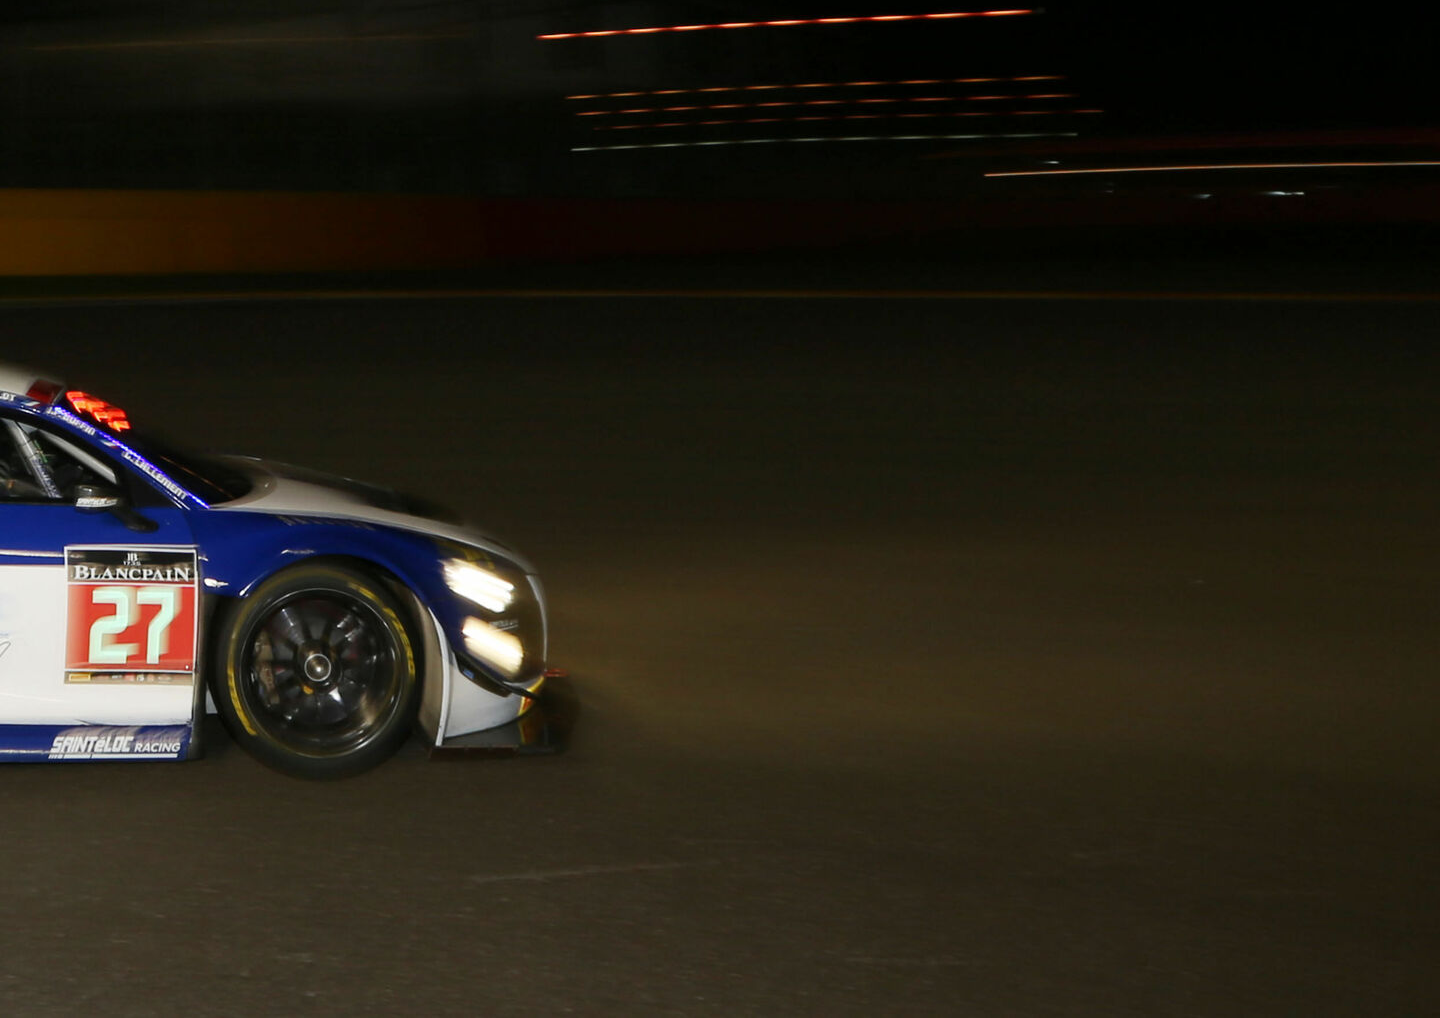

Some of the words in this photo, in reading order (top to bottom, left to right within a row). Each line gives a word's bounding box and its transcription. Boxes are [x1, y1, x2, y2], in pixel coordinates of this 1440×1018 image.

[74, 565, 191, 582] BLANCPAIN
[88, 587, 177, 664] 27
[133, 742, 181, 753] RACING
